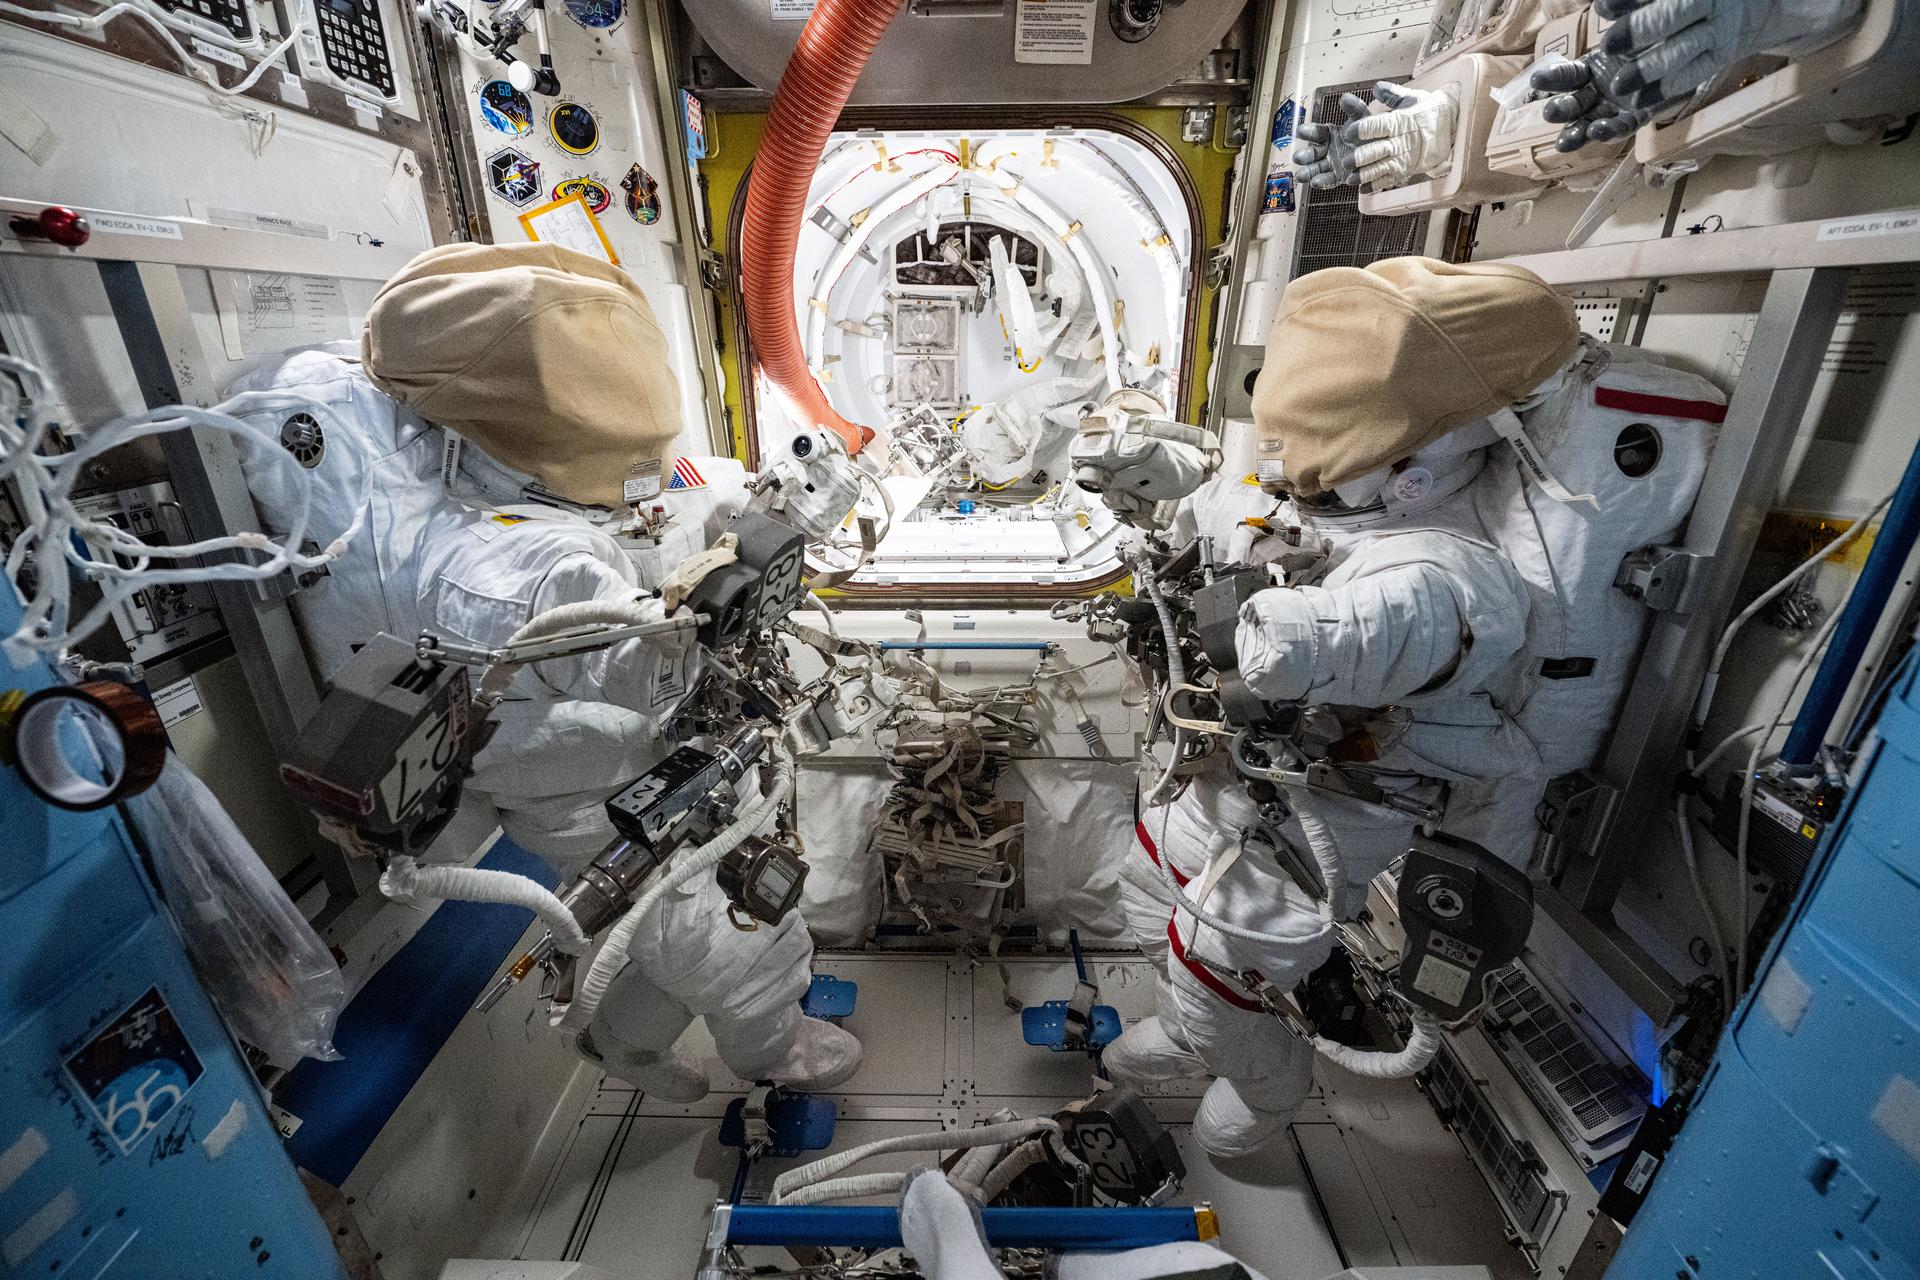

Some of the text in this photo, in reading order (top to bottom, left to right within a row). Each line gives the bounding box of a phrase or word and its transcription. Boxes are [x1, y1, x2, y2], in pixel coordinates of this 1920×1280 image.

[585, 1, 602, 17] 64
[498, 83, 512, 97] 68
[95, 219, 113, 227] FWD
[1827, 226, 1842, 234] AFT
[632, 784, 655, 799] 2
[652, 812, 668, 832] 2
[105, 1069, 181, 1147] 65
